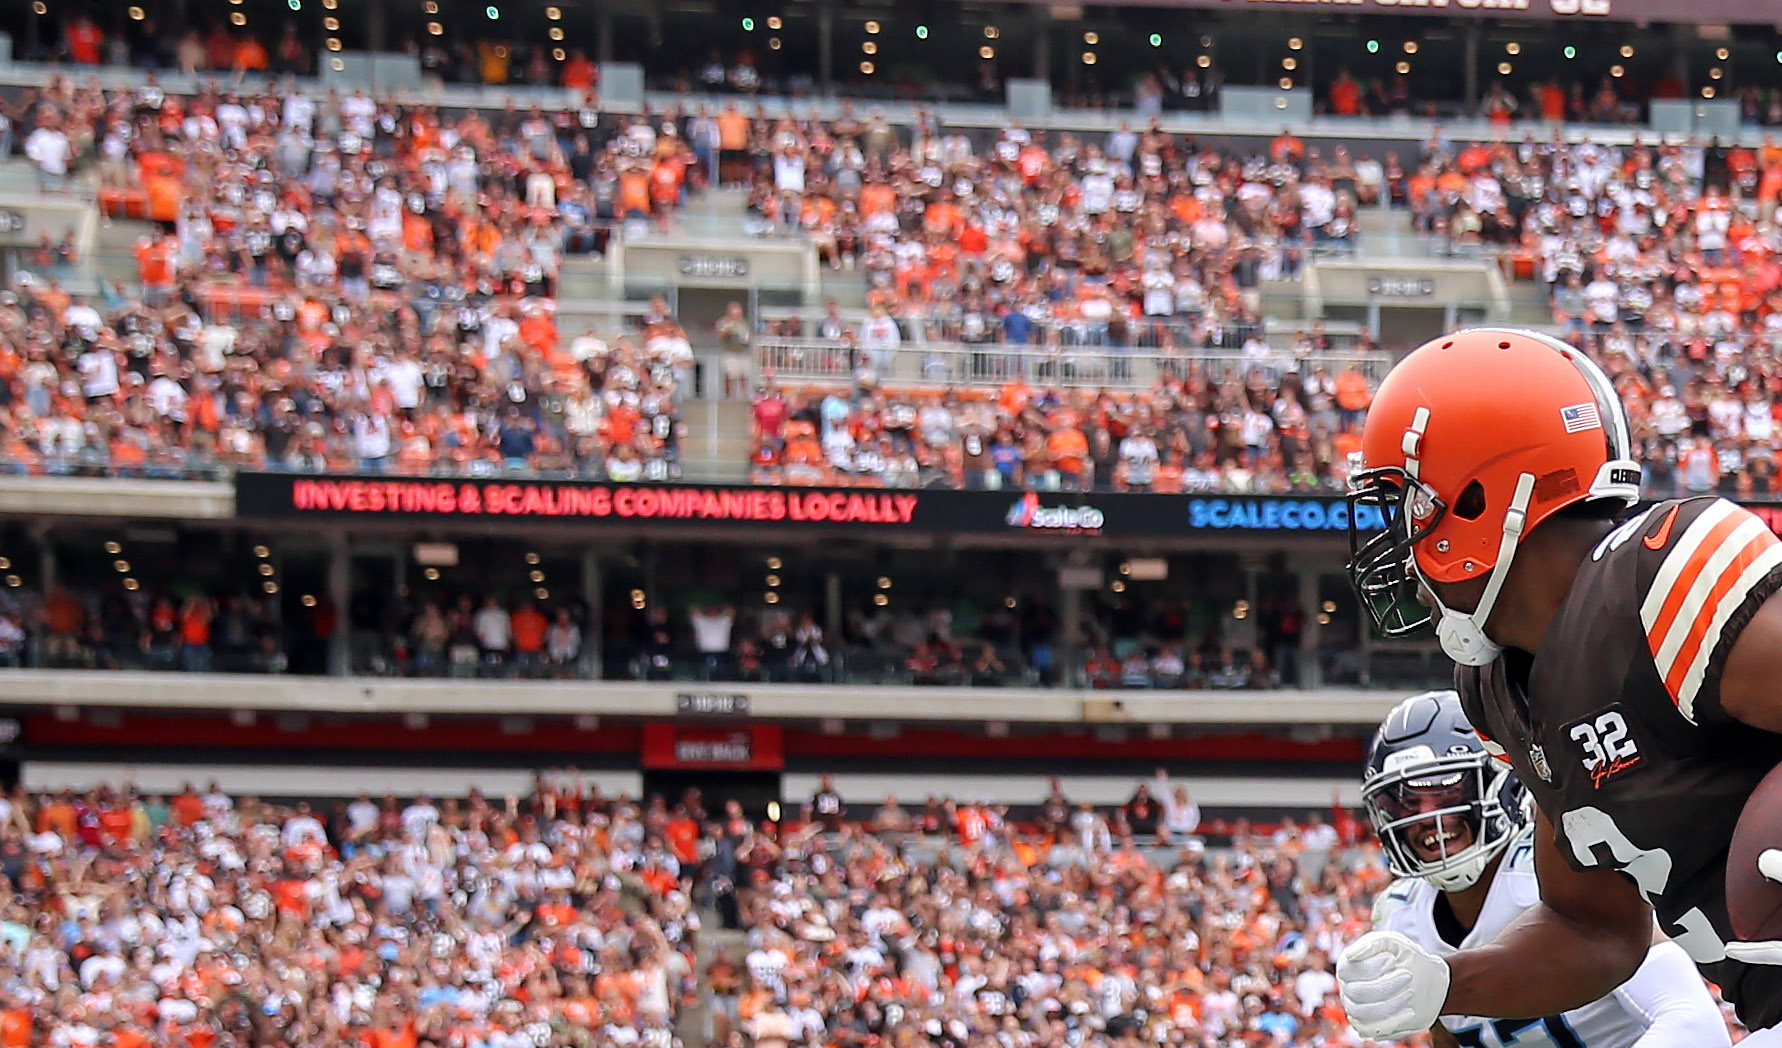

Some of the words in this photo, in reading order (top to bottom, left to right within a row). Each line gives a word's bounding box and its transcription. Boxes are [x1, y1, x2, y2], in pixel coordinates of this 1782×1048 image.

[293, 480, 456, 513] INVESTING
[459, 486, 481, 515] &
[483, 486, 612, 518] SCALING
[616, 490, 785, 521] COMPANIES
[789, 493, 918, 524] LOCALLY
[1570, 711, 1638, 771] 32
